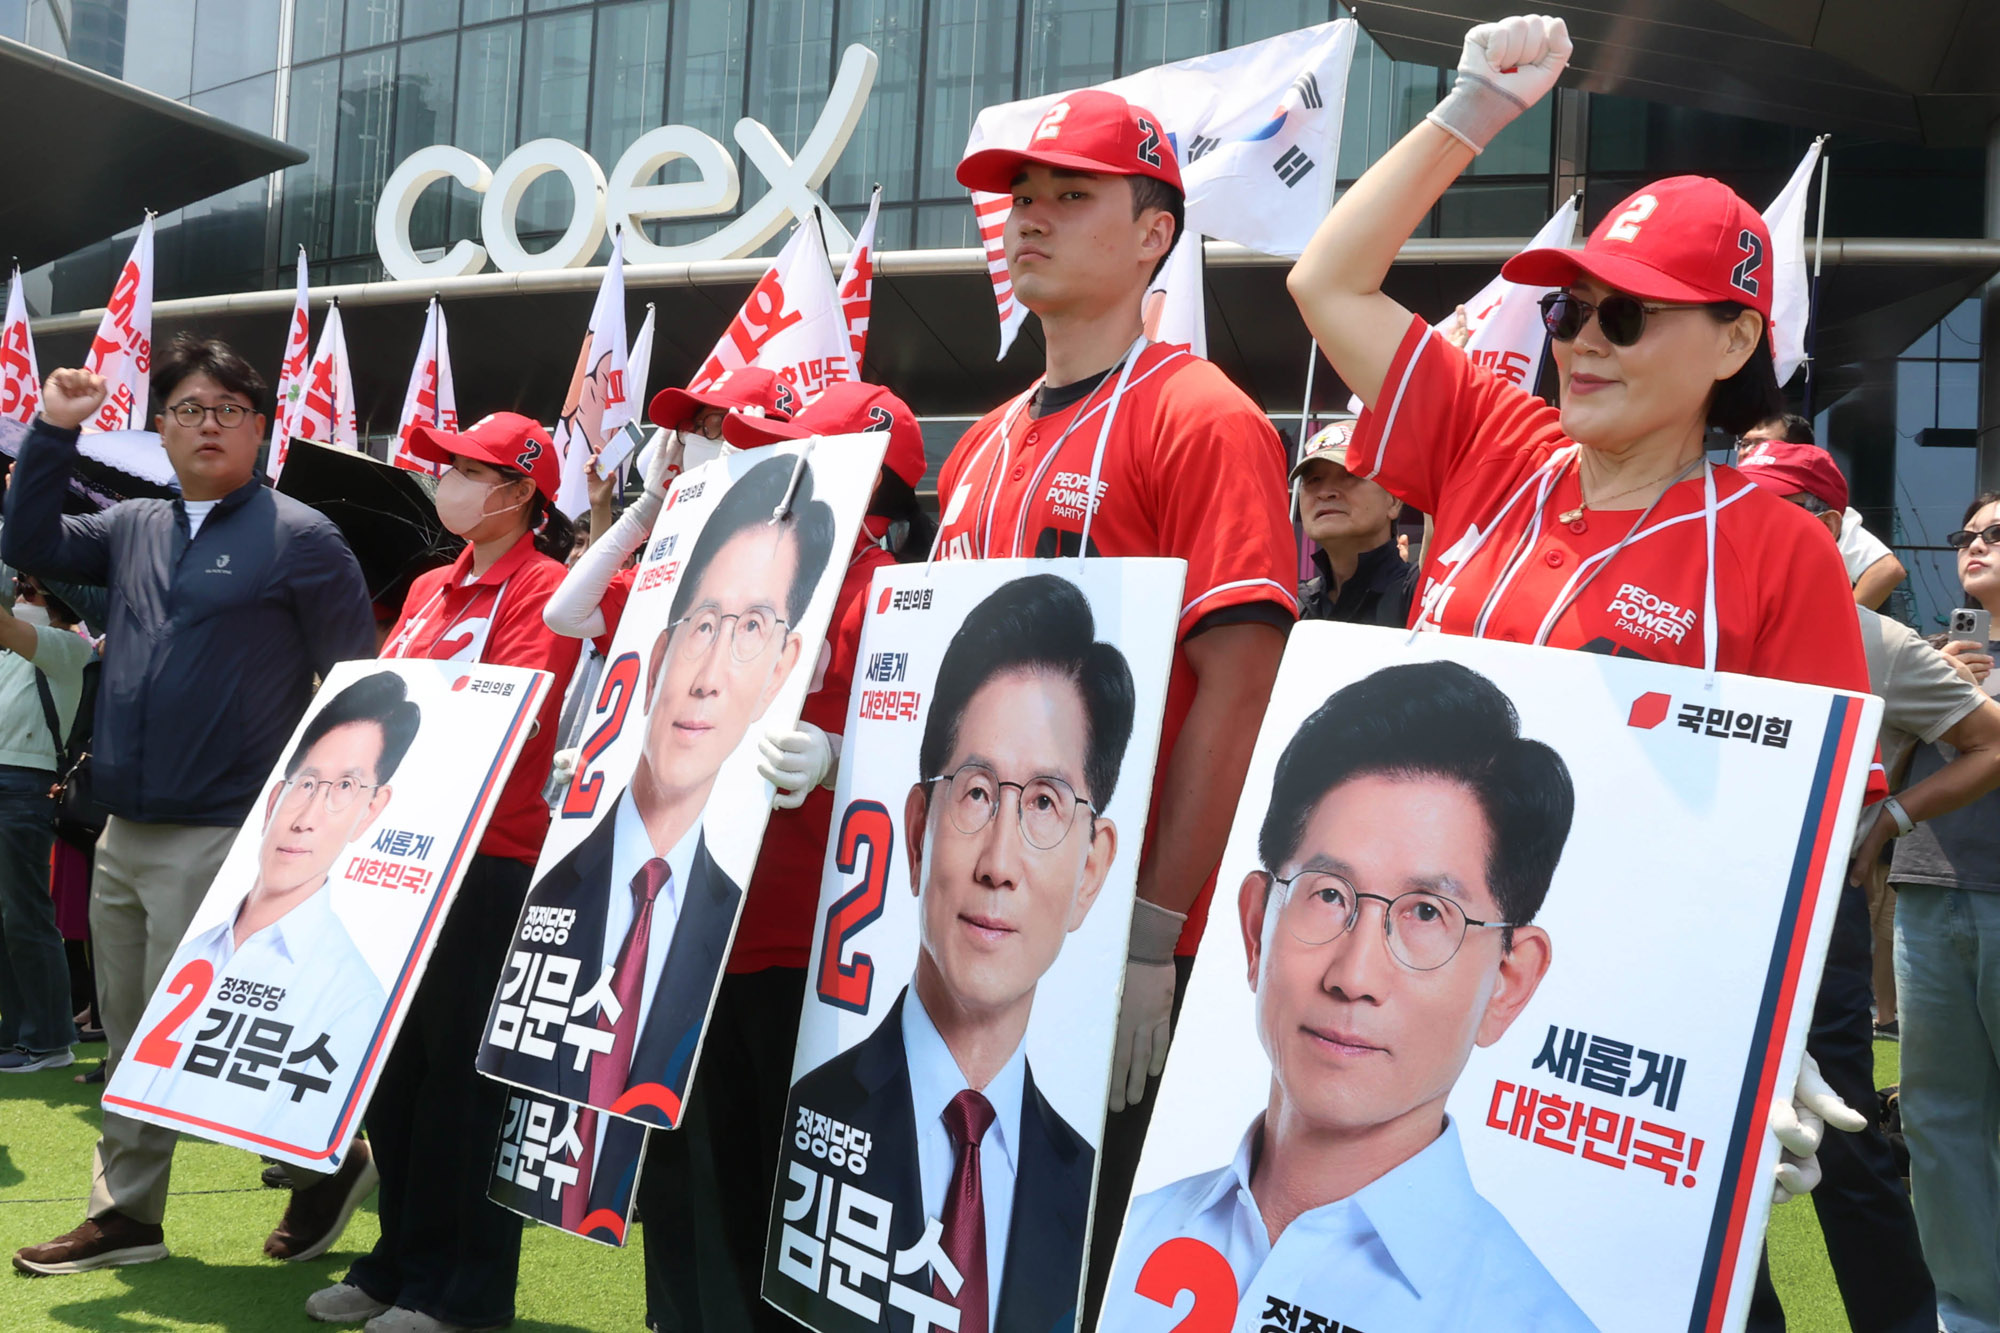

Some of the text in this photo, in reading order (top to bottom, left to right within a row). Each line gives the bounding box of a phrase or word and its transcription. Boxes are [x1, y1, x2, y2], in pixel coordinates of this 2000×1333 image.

[1035, 101, 1071, 141] 2
[1137, 116, 1163, 170] 2
[374, 42, 878, 281] coex
[1604, 194, 1659, 243] 2
[1730, 228, 1764, 298] 2
[775, 384, 793, 416] 2
[515, 438, 543, 473] 2
[1052, 505, 1084, 521] PARTY
[637, 561, 681, 593] 대한민국!
[894, 588, 933, 611] 국민의힘
[1606, 599, 1686, 646] POWER
[1616, 583, 1697, 630] PEOPLE
[1615, 618, 1665, 644] PARTY
[470, 679, 515, 697] 국민의힘
[865, 652, 908, 682] 새롭게
[859, 690, 921, 722] 대한민국!
[1676, 702, 1793, 750] 국민의힘
[561, 651, 640, 819] 2
[371, 828, 434, 861] 새롭게
[345, 857, 433, 895] 대한민국!
[521, 906, 576, 945] 정정당당
[817, 798, 893, 1016] 2
[133, 959, 214, 1069] 2
[217, 976, 286, 1011] 정정당당
[489, 950, 623, 1072] 김문수
[183, 1007, 339, 1103] 김문수
[1532, 1024, 1687, 1112] 새롭게
[496, 1095, 583, 1201] 김문수
[794, 1106, 872, 1176] 정정당당
[1485, 1079, 1705, 1189] 대한민국!
[778, 1161, 965, 1333] 김문수
